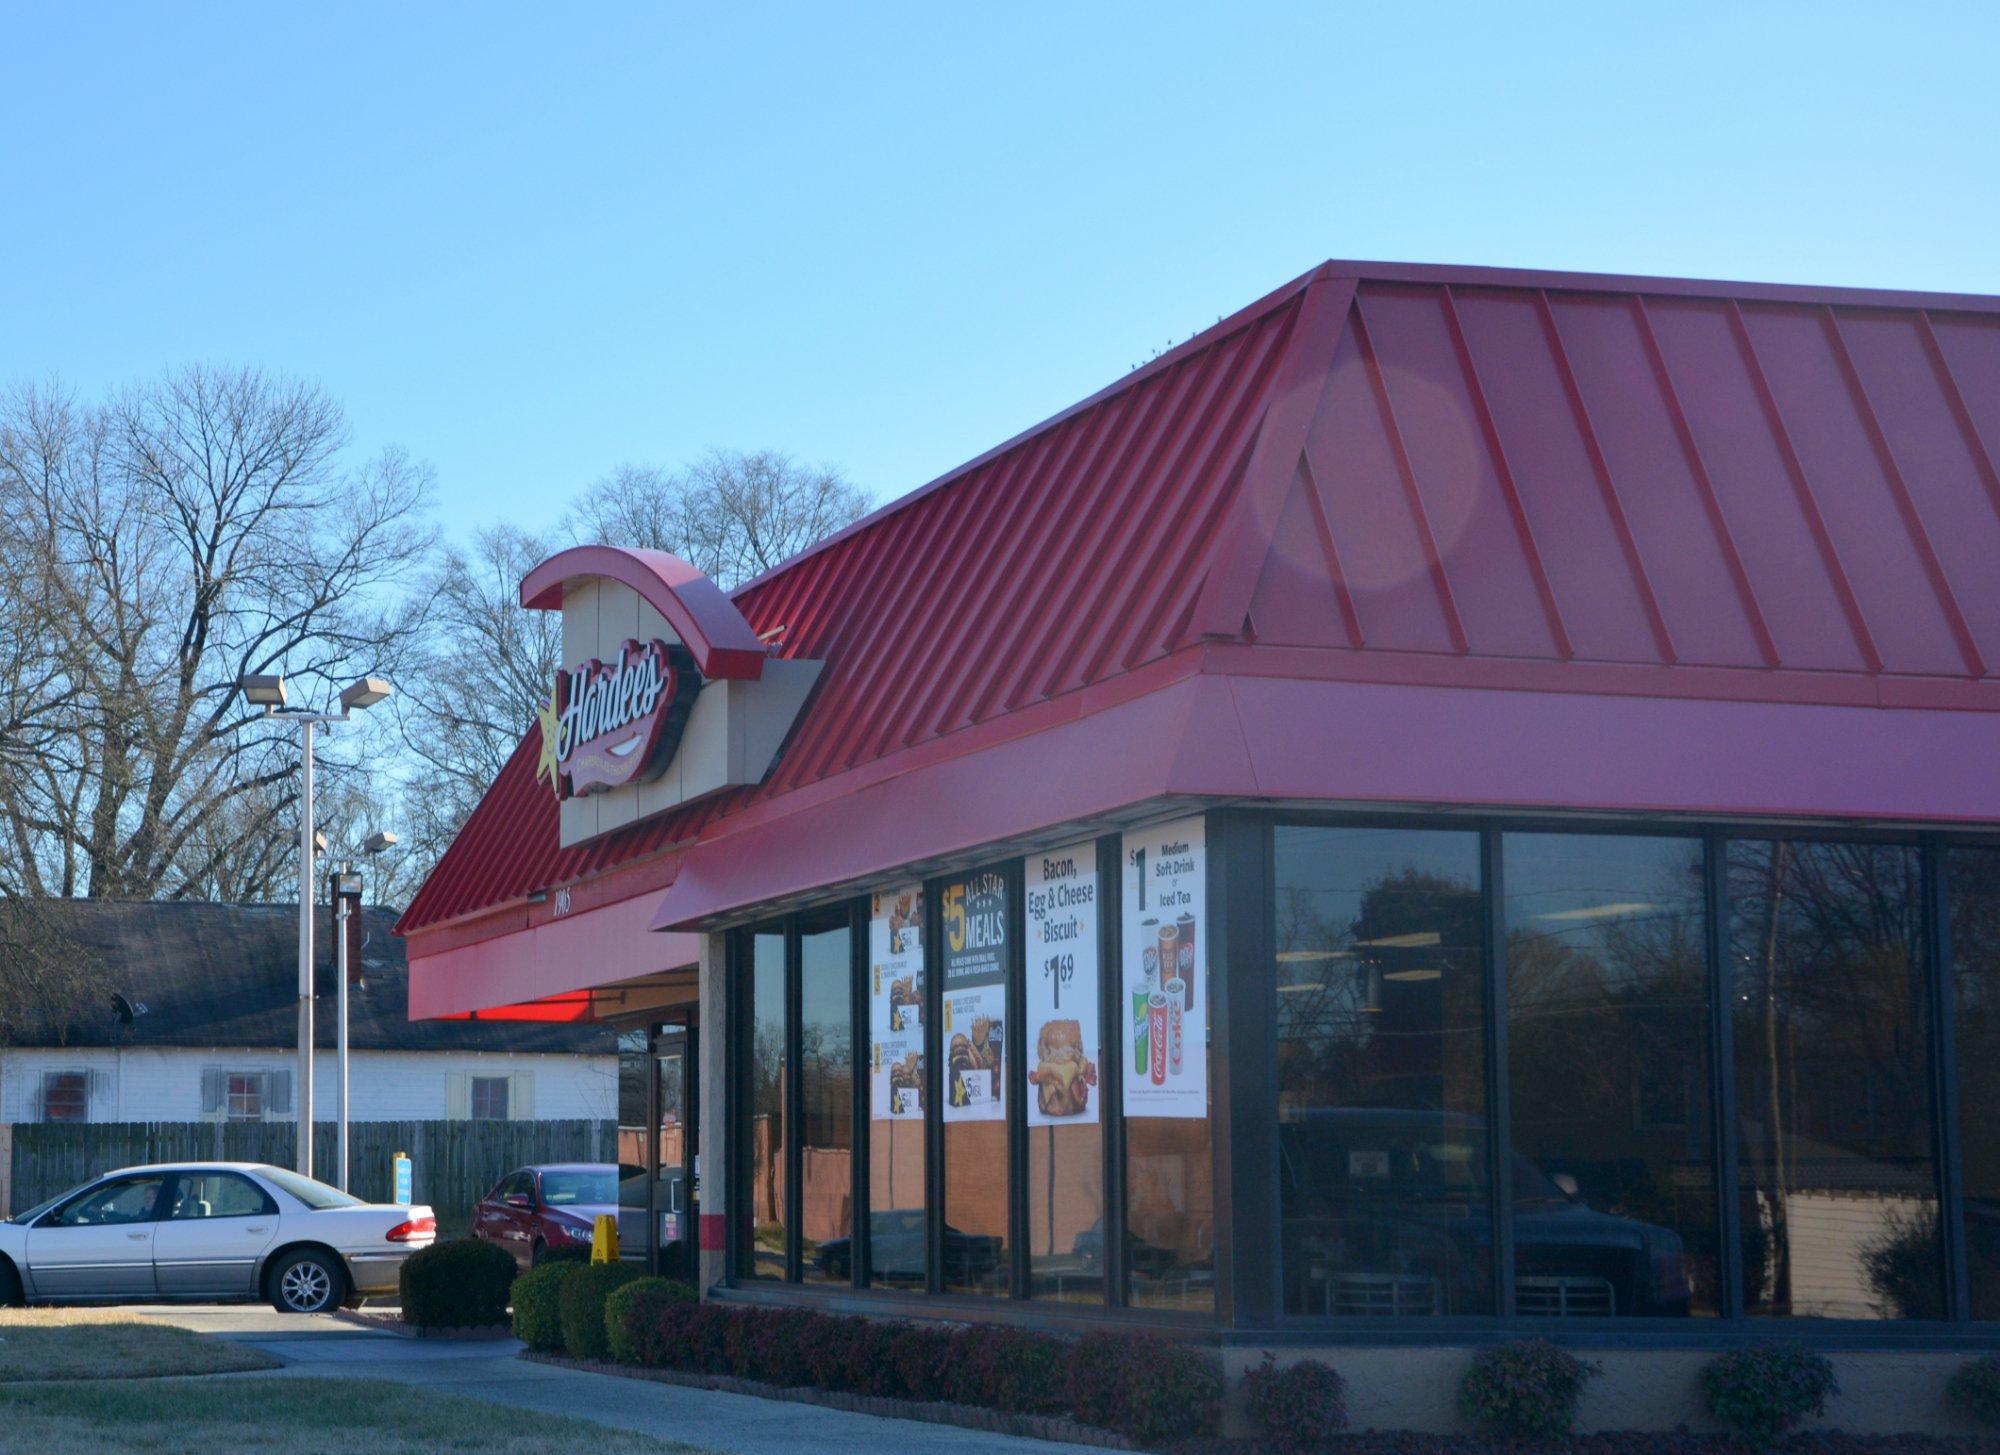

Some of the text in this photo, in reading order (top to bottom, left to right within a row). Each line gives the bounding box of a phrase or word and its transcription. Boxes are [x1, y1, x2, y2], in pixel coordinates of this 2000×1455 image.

[555, 643, 664, 762] Hardee's
[1161, 841, 1189, 856] Medium
[1043, 858, 1077, 880] Bacon,
[1130, 847, 1146, 911] $1
[1156, 857, 1195, 877] Soft Drink
[965, 873, 1004, 907] ALL STAR
[1028, 883, 1094, 920] Egg & Cheese
[1160, 890, 1191, 907] Iced Tea
[943, 884, 966, 952] $5
[965, 910, 1004, 949] MEALS
[1043, 914, 1078, 943] Biscuit
